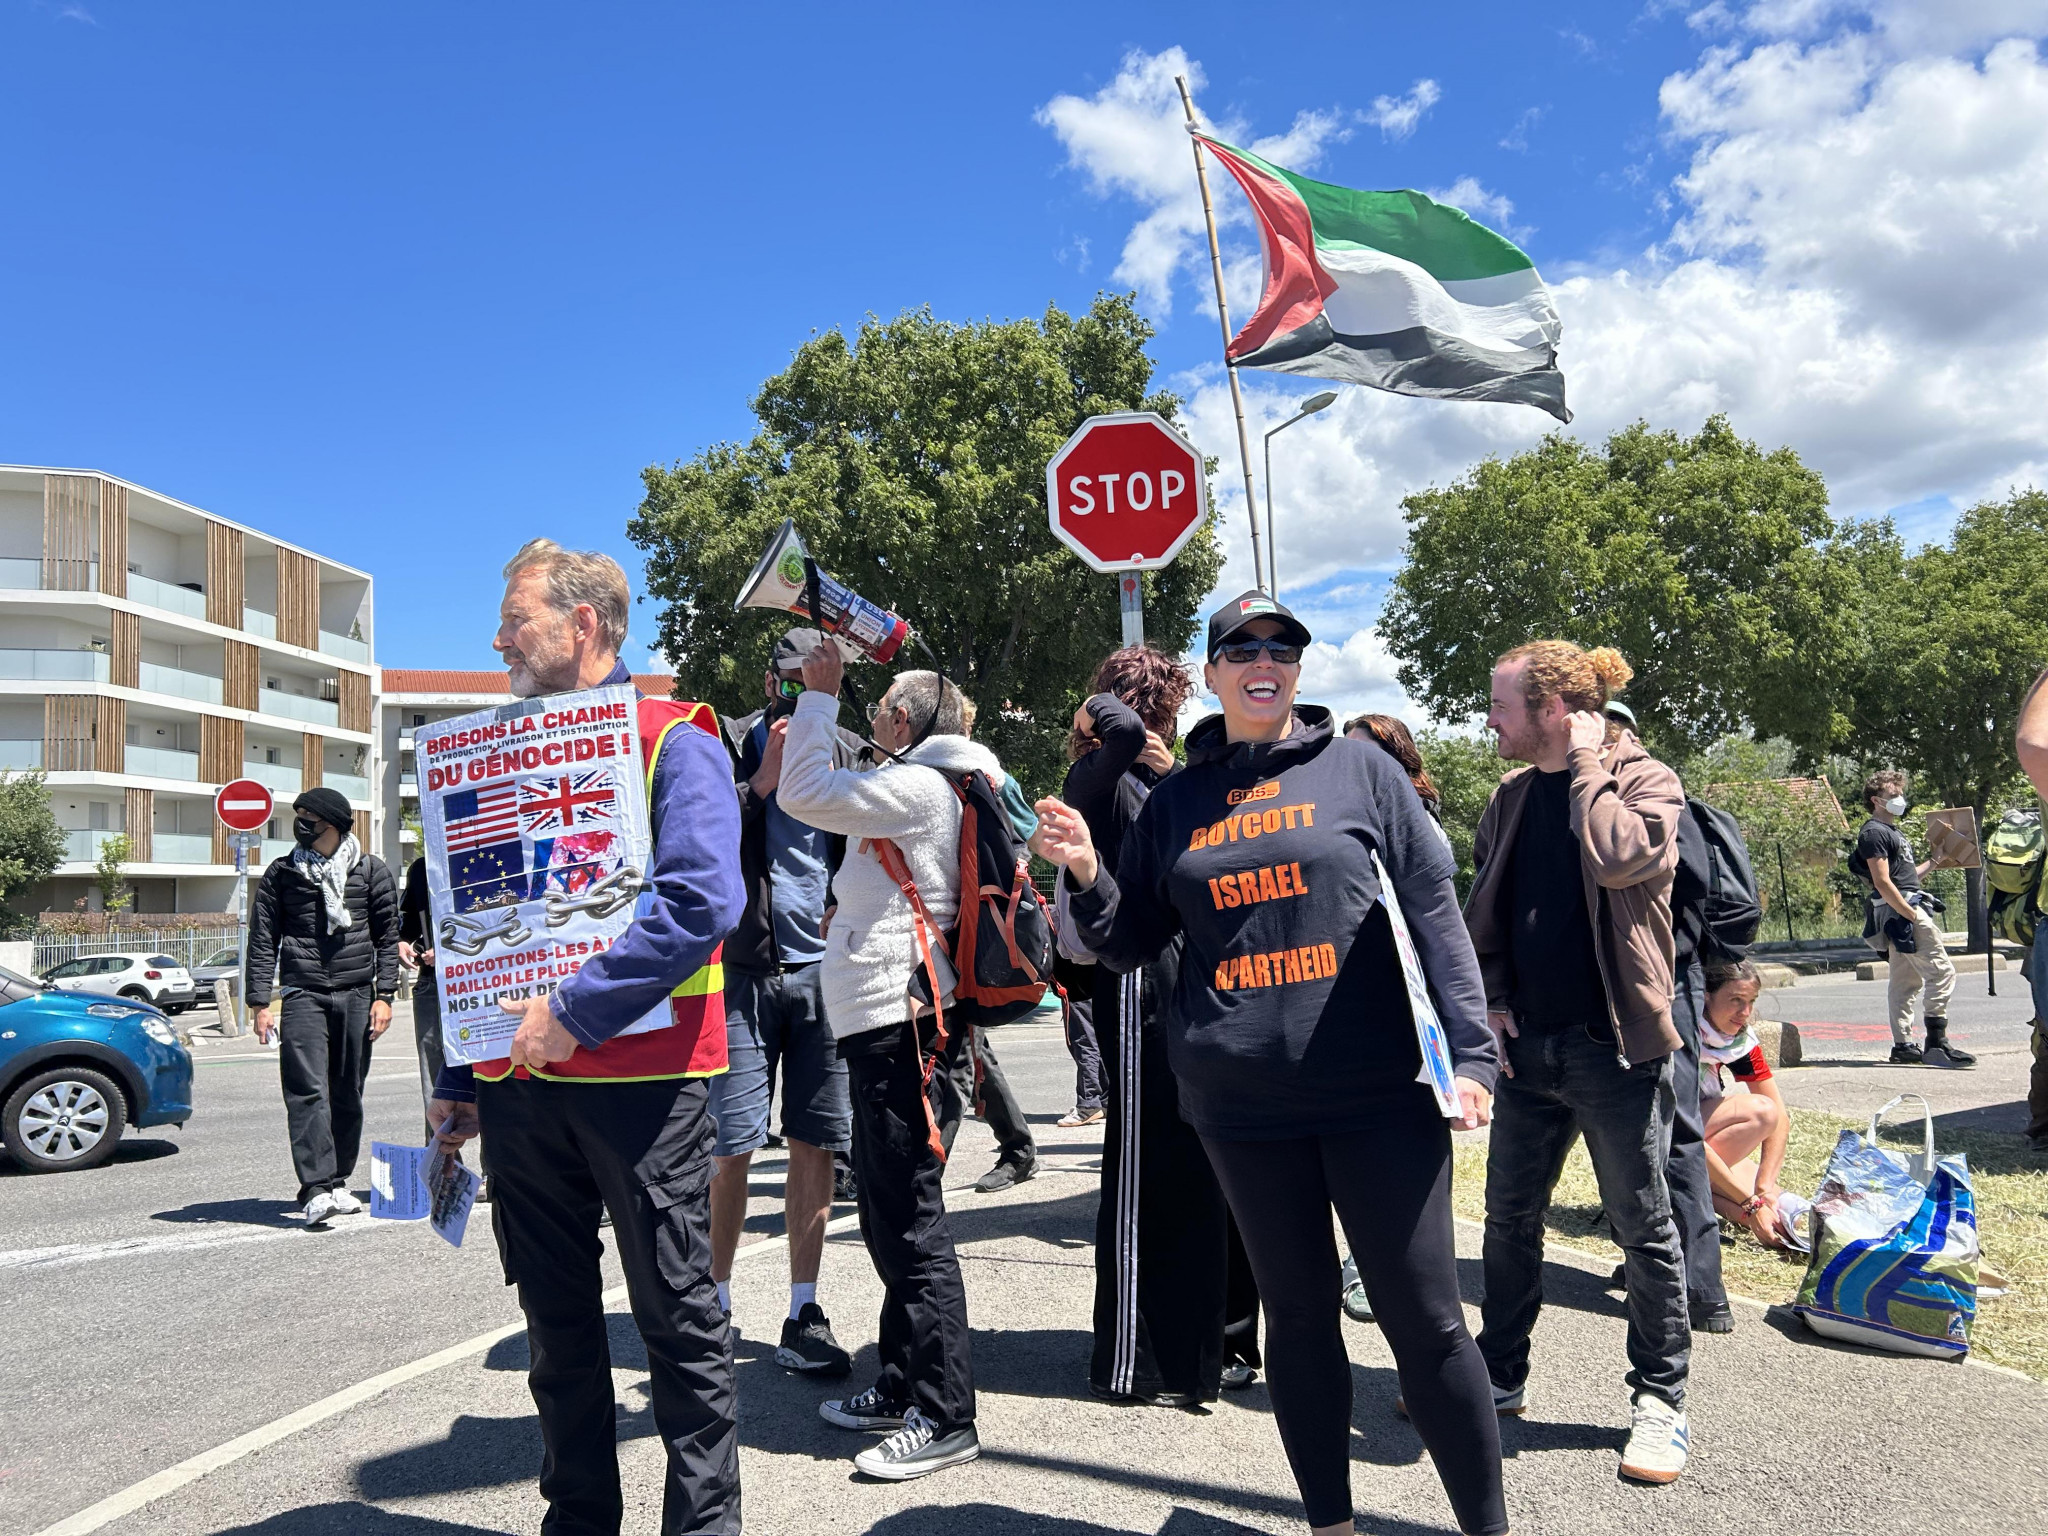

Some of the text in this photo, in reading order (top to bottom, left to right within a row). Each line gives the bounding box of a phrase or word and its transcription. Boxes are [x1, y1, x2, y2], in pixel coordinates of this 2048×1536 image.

[1069, 469, 1186, 516] STOP
[861, 613, 881, 628] UNION
[426, 702, 628, 755] BRISONS LA CHAINE
[430, 756, 440, 764] DE
[497, 733, 543, 749] LIVRAISON
[546, 731, 558, 739] ET
[560, 721, 629, 737] DISTRIBUTION
[427, 762, 463, 792] DU
[467, 734, 616, 782] GÉNOCIDE
[1188, 803, 1316, 852] BOYCOTT
[1208, 862, 1308, 911] ISRAEL
[445, 941, 589, 979] BOYCOTTONS-LES
[592, 936, 605, 953] À
[446, 961, 581, 996] MAILLON LE PLUS
[1215, 943, 1338, 991] APARTHEID
[448, 996, 479, 1014] NOS
